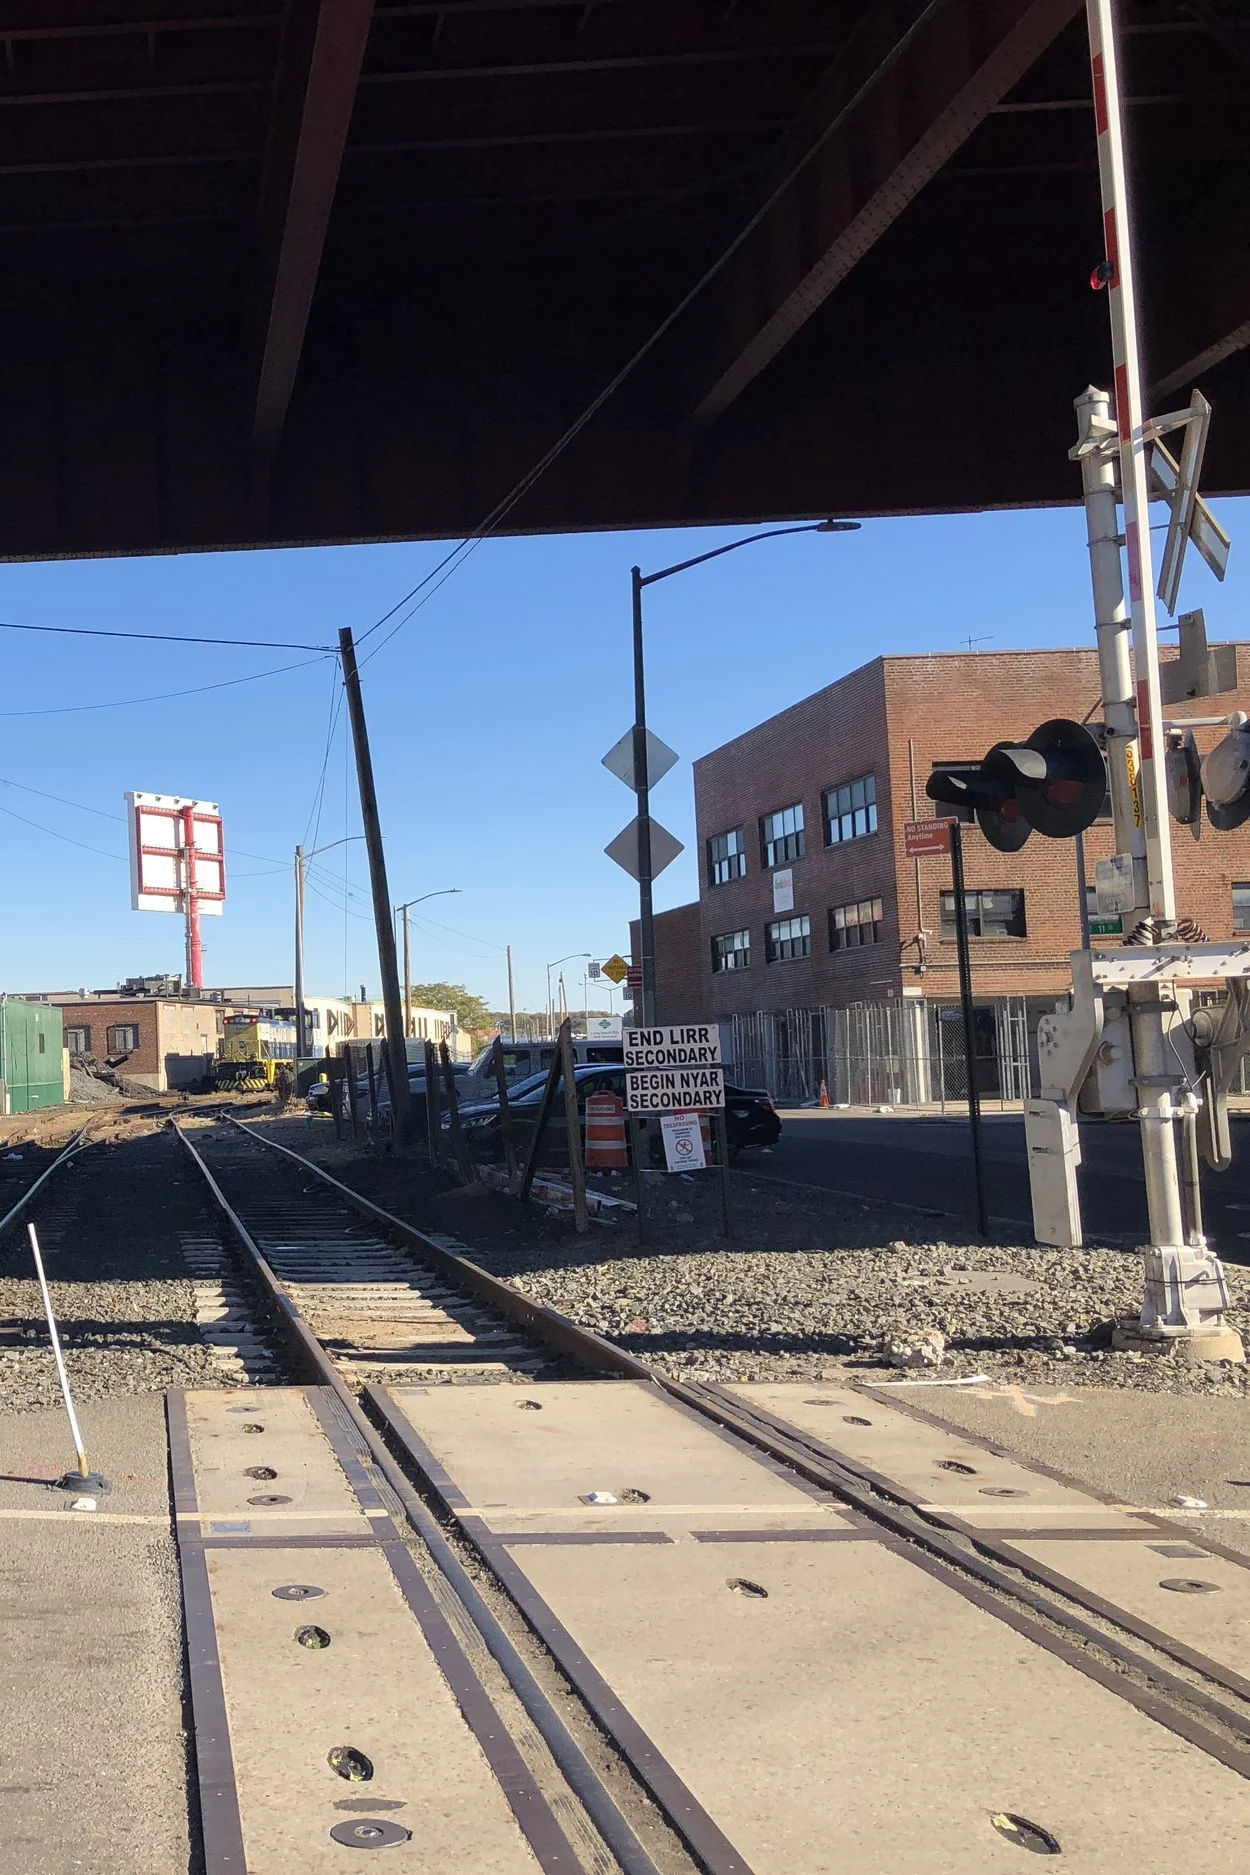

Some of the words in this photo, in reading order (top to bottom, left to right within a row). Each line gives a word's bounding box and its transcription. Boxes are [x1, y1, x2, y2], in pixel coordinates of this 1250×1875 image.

[917, 821, 949, 832] STANDING
[907, 832, 933, 841] Anytime
[1098, 925, 1106, 933] 11
[629, 1030, 664, 1047] END
[670, 1027, 710, 1045] LIRR
[625, 1046, 718, 1066] SECONDARY
[630, 1073, 675, 1091] BEGIN
[680, 1071, 720, 1089] NYAR
[630, 1089, 722, 1109] SECONDARY
[663, 1119, 698, 1129] TRESPASSING
